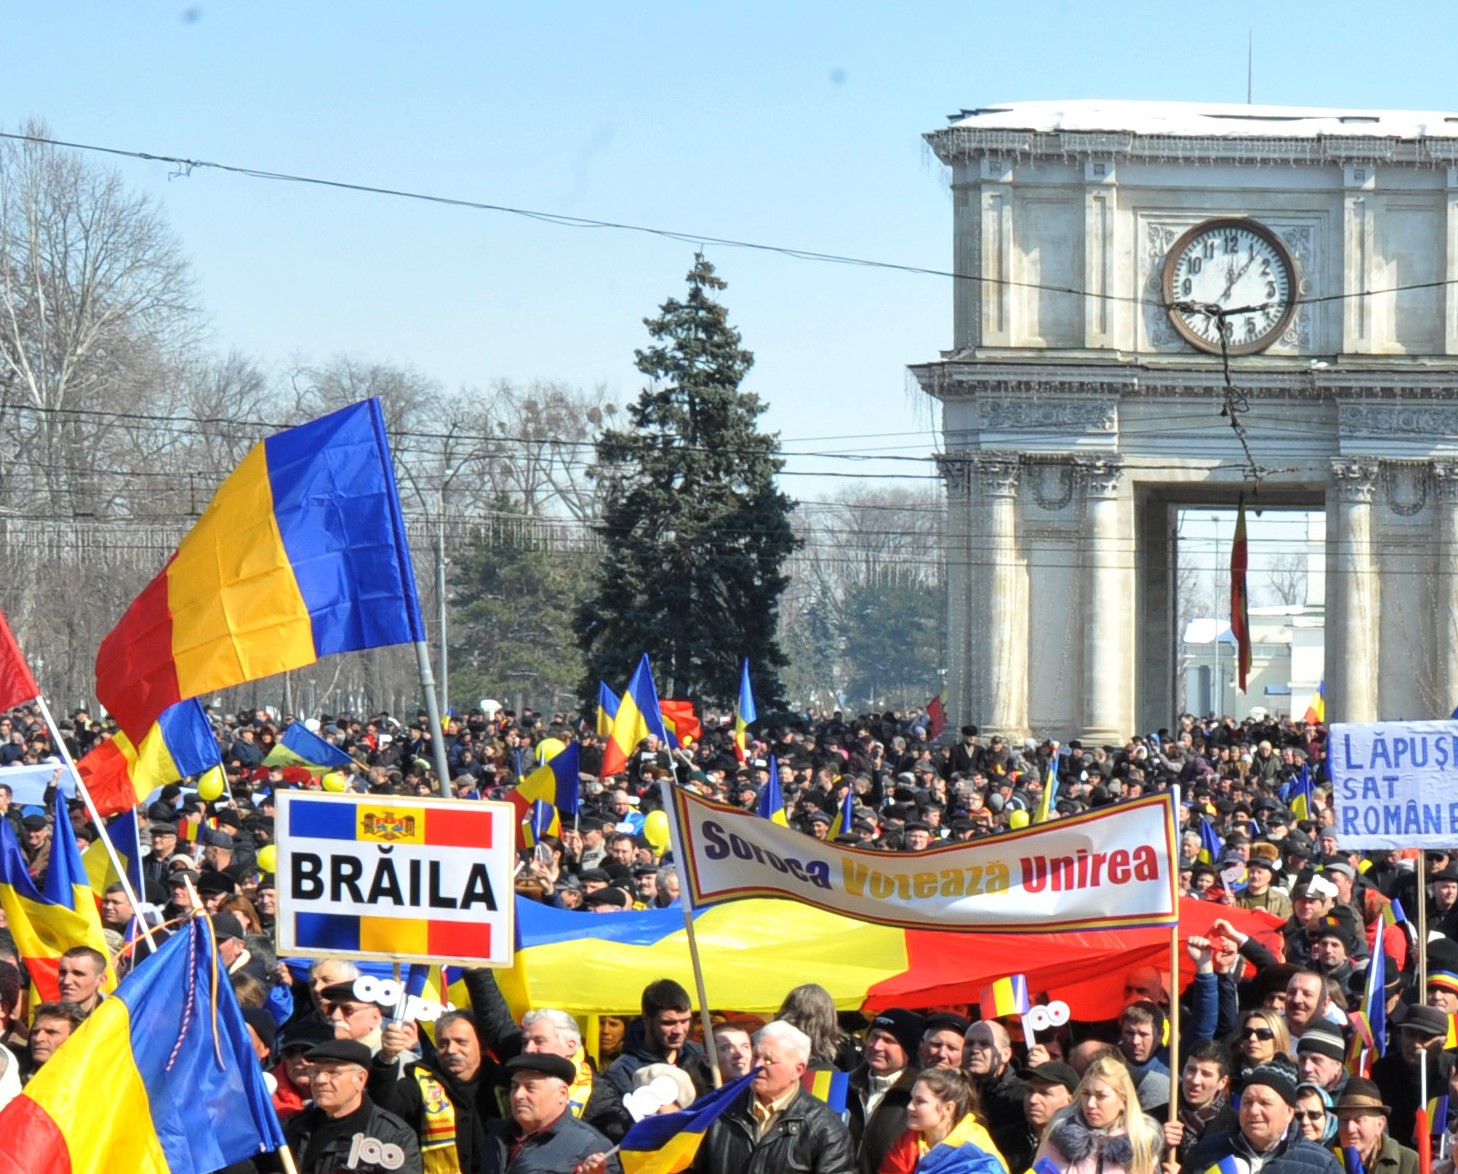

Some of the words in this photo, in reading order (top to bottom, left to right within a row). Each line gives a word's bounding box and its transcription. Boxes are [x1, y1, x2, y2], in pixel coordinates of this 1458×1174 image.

[1203, 241, 1215, 259] 11
[1224, 235, 1238, 254] 12
[1249, 243, 1255, 258] 1
[1187, 256, 1202, 274] 10
[1261, 258, 1271, 276] 2
[1183, 278, 1192, 295] 9
[1266, 280, 1276, 298] 3
[1247, 317, 1256, 334] 5
[1343, 776, 1399, 801] SAT
[701, 820, 832, 891] Soroca
[841, 856, 1010, 901] Votează
[1019, 844, 1159, 894] Unirea
[290, 844, 498, 912] BRĂILA
